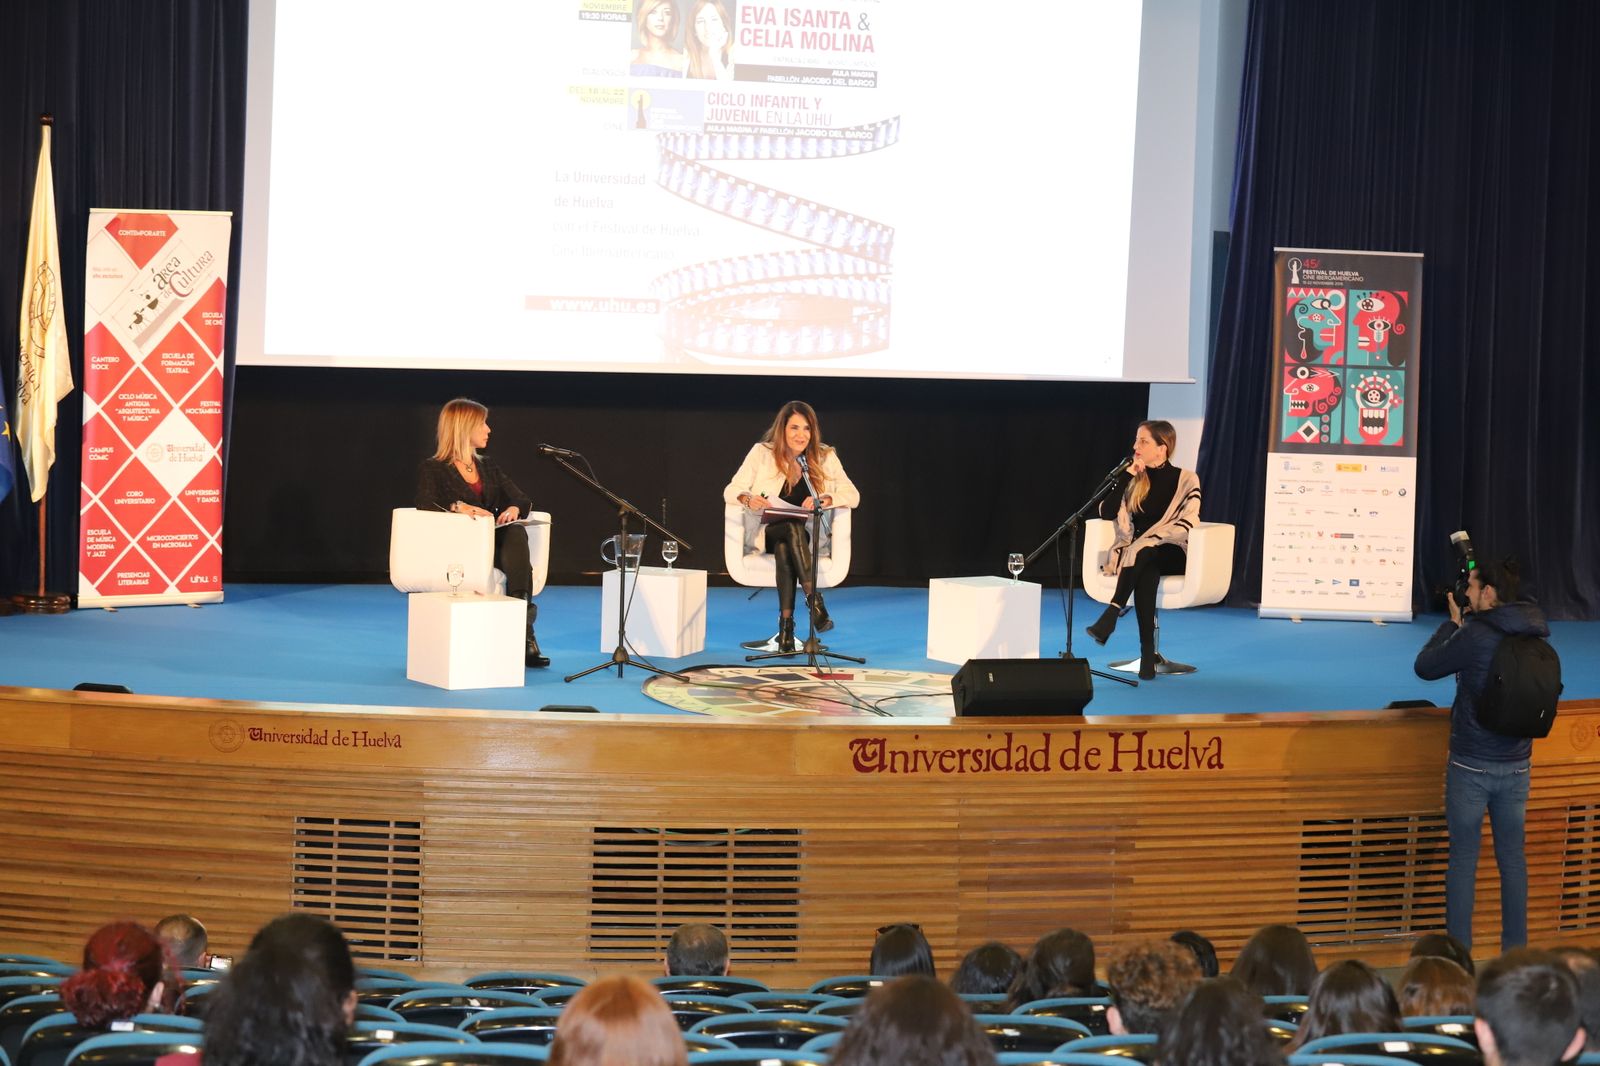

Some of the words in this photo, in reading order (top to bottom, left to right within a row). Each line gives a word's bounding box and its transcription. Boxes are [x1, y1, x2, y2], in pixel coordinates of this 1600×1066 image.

[741, 5, 777, 26] EVA
[784, 7, 851, 30] ISANTA
[857, 12, 870, 31] &
[740, 28, 794, 48] CELIA
[800, 31, 875, 53] MOLINA
[801, 76, 831, 85] JACOBO
[833, 78, 847, 86] DEL
[848, 79, 874, 87] BARCO
[707, 92, 745, 107] CICLO
[750, 94, 809, 110] INFANTIL
[814, 97, 822, 110] Y
[706, 108, 762, 123] JUVENIL
[766, 110, 783, 124] EN
[786, 111, 802, 125] LA
[806, 113, 832, 126] UHU
[795, 128, 827, 137] JACOBO
[829, 129, 843, 138] DEL
[845, 130, 873, 139] BARCO
[555, 170, 569, 183] La
[573, 170, 646, 185] Universidad
[553, 194, 569, 207] de
[572, 195, 614, 209] Huelva
[549, 298, 656, 314] www.uhu.es
[114, 497, 156, 505] UNIVERSITARIO
[247, 727, 328, 746] Universidad
[332, 730, 349, 746] de
[351, 731, 402, 748] Huelva
[848, 731, 1051, 773] Universidad
[1059, 730, 1101, 771] de
[1107, 730, 1224, 772] Huelva
